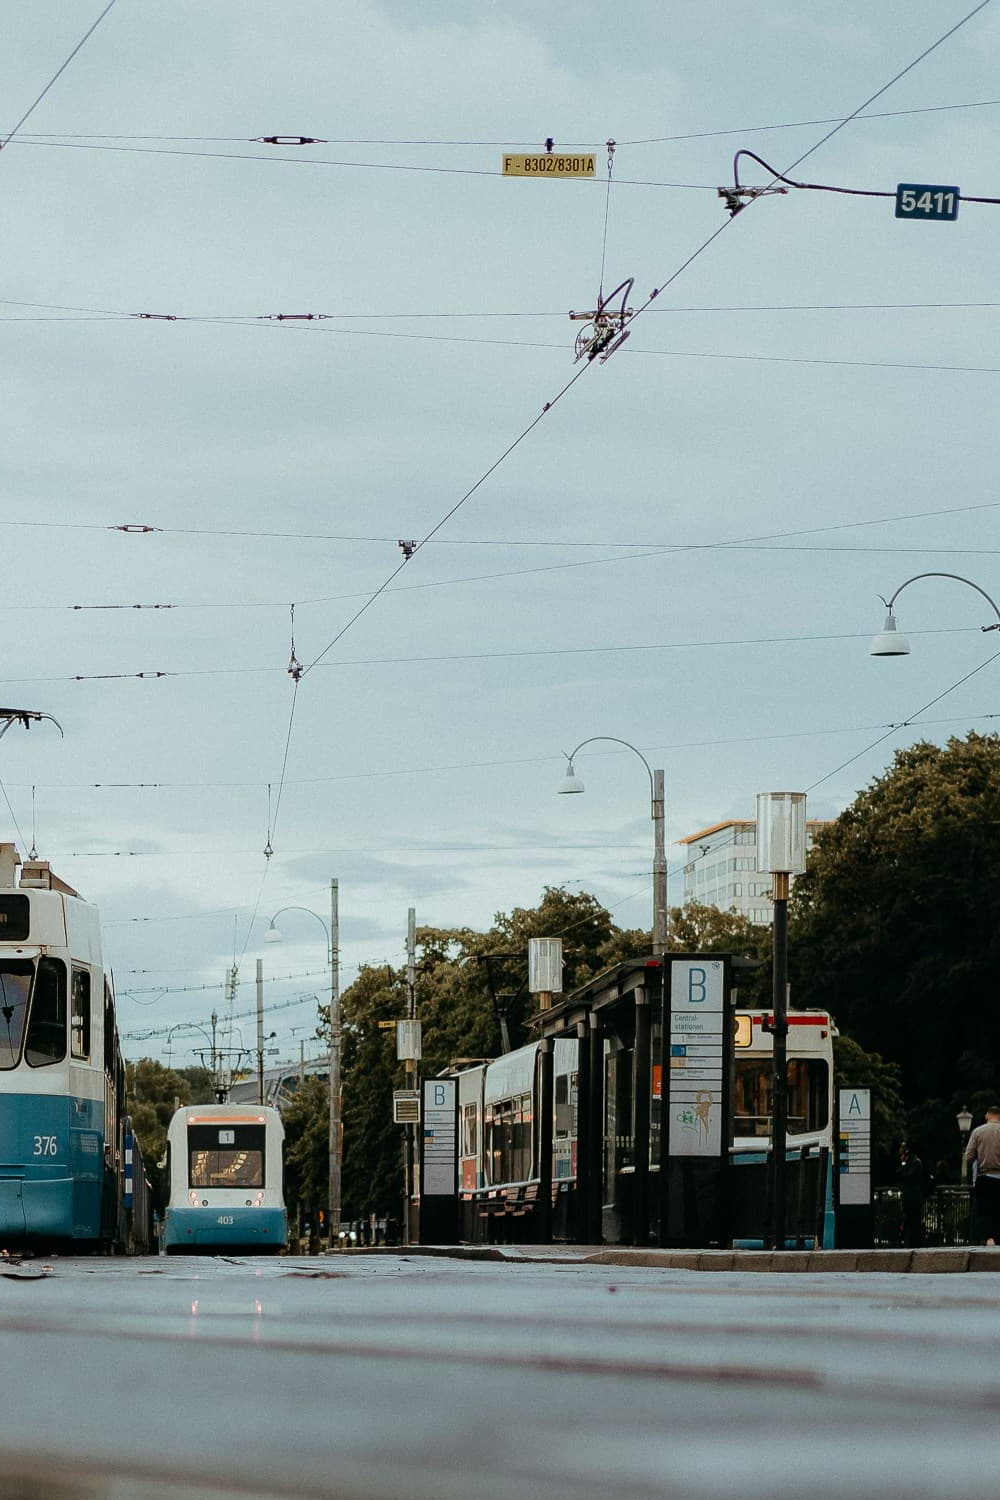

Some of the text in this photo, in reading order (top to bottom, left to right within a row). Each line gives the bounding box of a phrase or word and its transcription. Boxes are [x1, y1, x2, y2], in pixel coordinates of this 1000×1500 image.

[505, 158, 512, 171] F
[524, 158, 594, 172] 8302/8301A
[901, 190, 954, 214] 5411
[688, 967, 706, 1003] B
[434, 1085, 446, 1105] B
[848, 1093, 861, 1115] A
[33, 1135, 57, 1155] 376
[217, 1216, 234, 1225] 403
